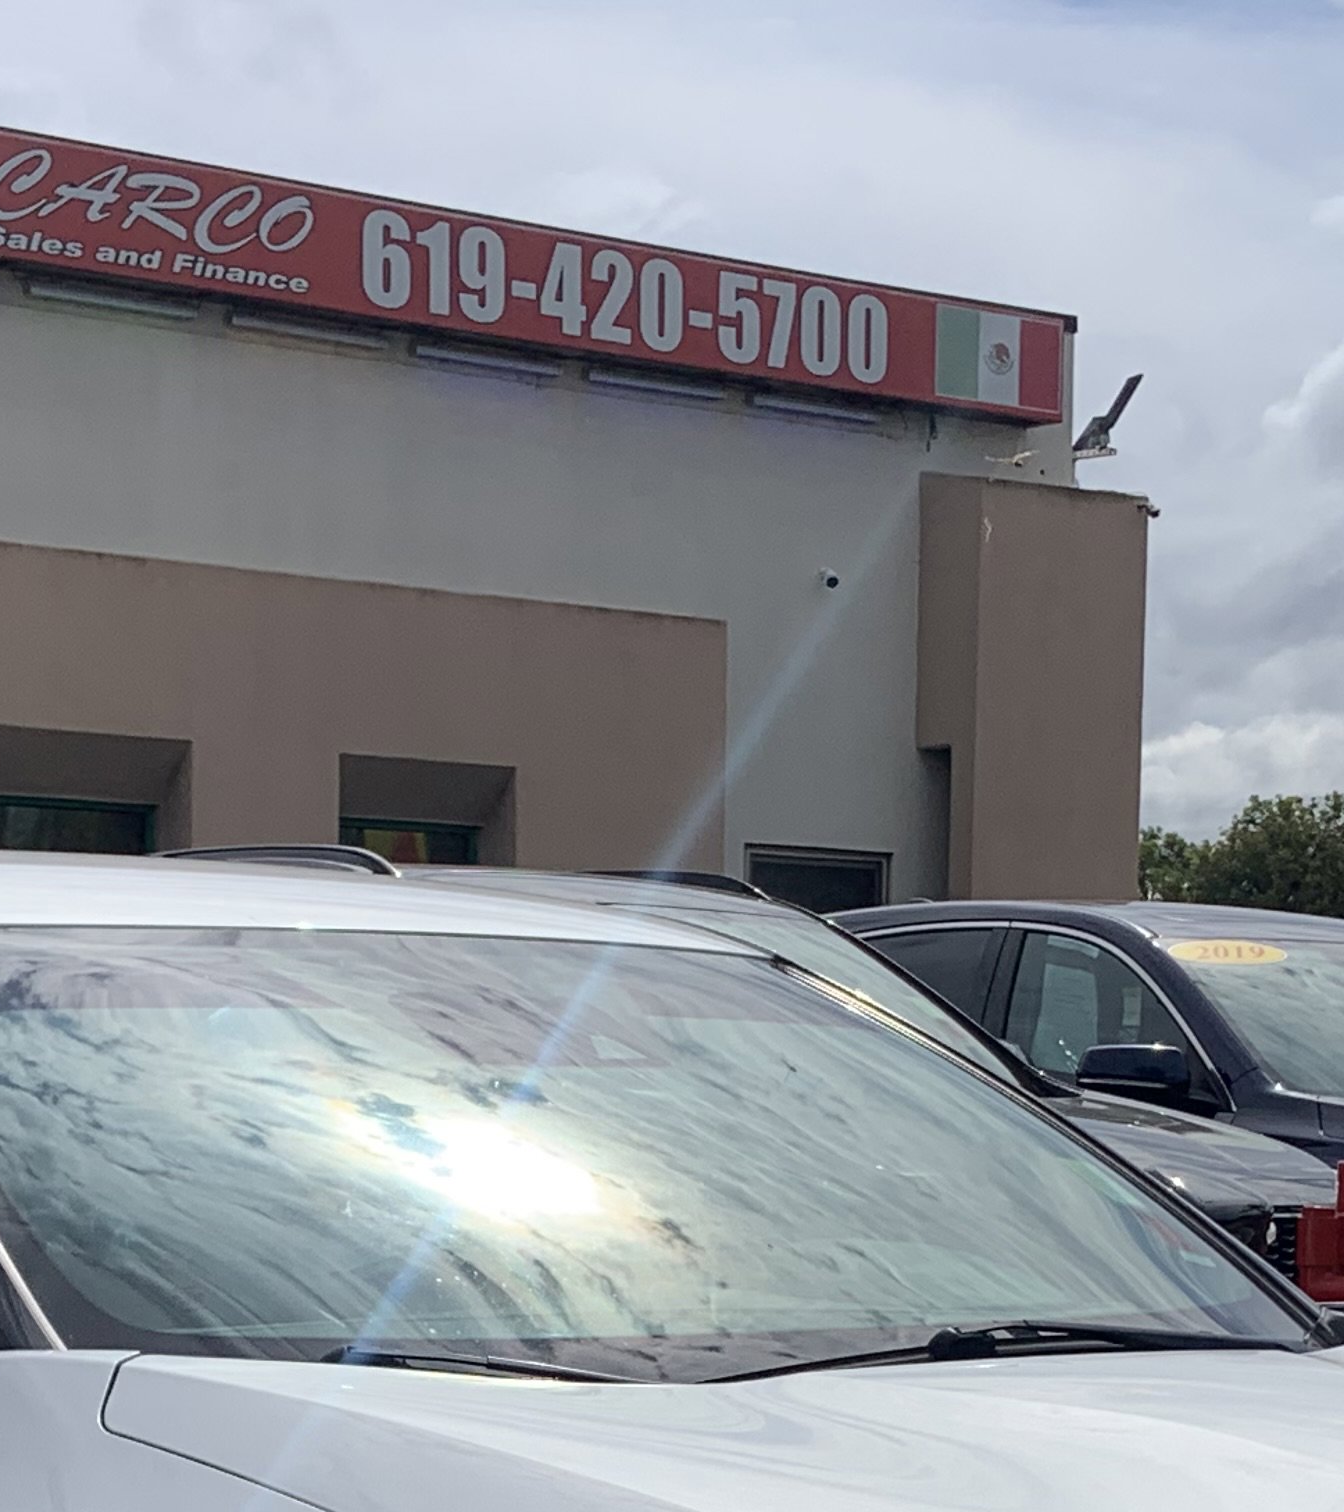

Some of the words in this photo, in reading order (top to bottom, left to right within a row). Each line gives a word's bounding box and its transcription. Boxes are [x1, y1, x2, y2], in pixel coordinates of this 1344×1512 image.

[95, 240, 159, 271] and
[172, 253, 311, 294] Finance
[361, 207, 890, 385] 619-420-5700
[1197, 946, 1265, 960] 2019
